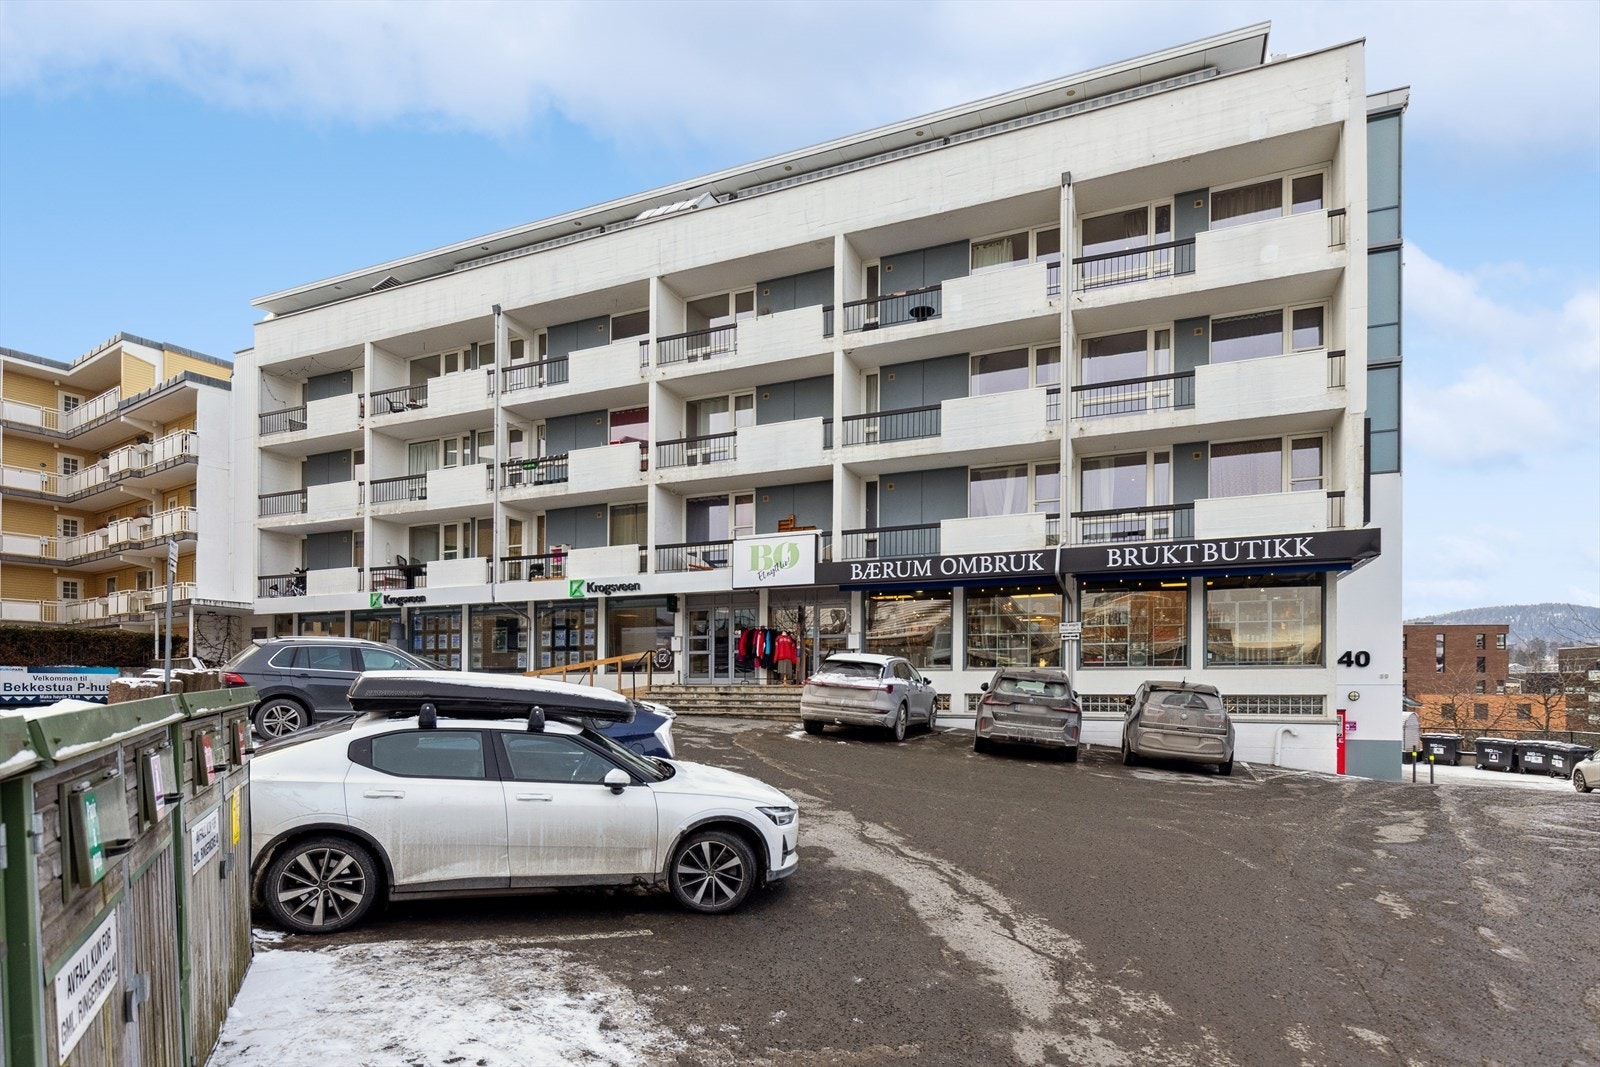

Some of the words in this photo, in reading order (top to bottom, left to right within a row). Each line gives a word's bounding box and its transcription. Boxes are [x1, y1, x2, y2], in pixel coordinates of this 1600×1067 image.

[1106, 544, 1198, 567] BRUKT
[1201, 537, 1315, 562] BUTIKK
[850, 559, 932, 581] BÆRUM
[940, 552, 1045, 576] OMBRUK
[586, 581, 641, 594] Krogsveen
[383, 594, 427, 606] Krogsveen
[1337, 650, 1371, 668] 40
[3, 682, 73, 692] Bekkestua
[67, 954, 91, 1000] AVFALL
[90, 938, 102, 970] KUN
[101, 926, 112, 956] FOR
